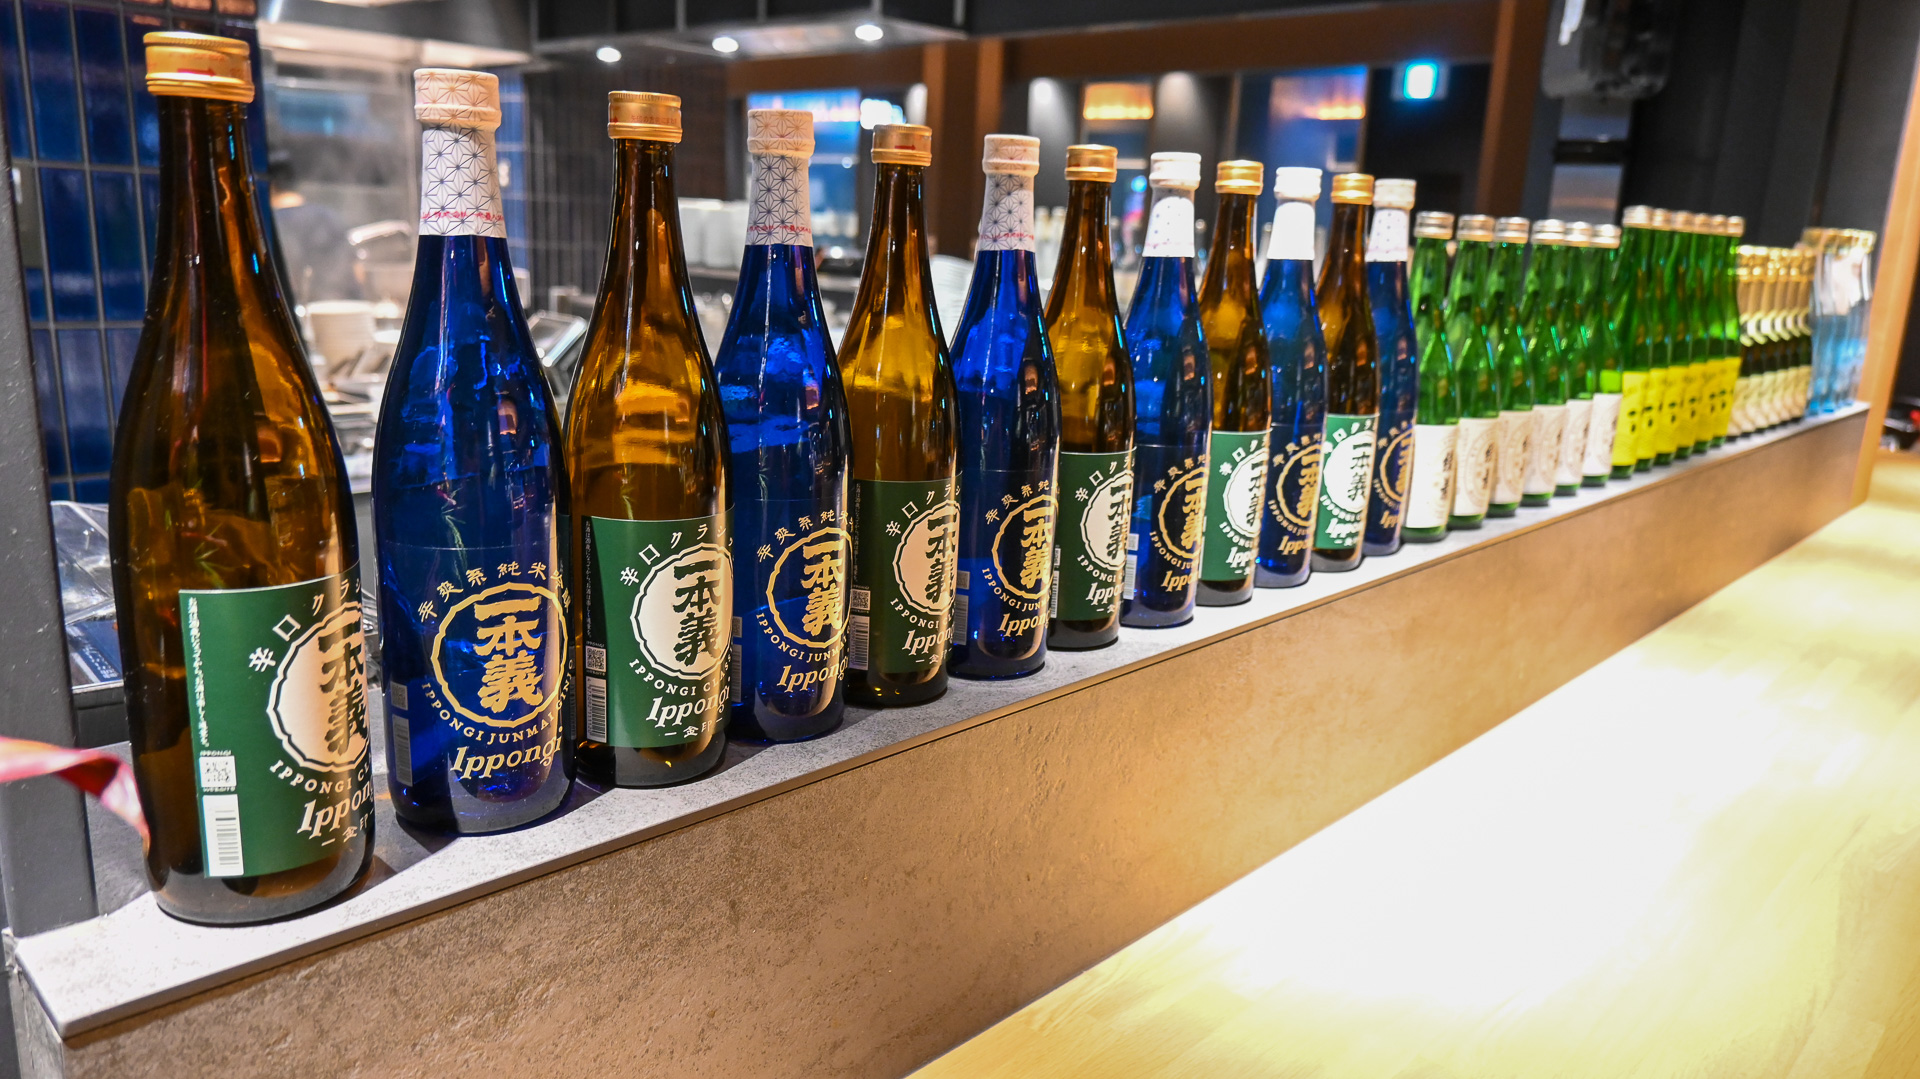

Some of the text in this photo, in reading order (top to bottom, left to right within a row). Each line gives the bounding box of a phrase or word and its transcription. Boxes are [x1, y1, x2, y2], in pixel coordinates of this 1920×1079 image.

[924, 512, 957, 604] 一本義
[1020, 506, 1053, 589] 一本義
[1077, 555, 1116, 582] IPPONGI
[1149, 531, 1182, 567] IPPONGI
[672, 559, 722, 667] 一本義
[801, 538, 844, 637] 一本義
[890, 598, 939, 629] IPPONGI
[982, 568, 1021, 609] IPPONGI
[473, 596, 543, 713] 一本義
[756, 613, 805, 660] IPPONGI
[318, 617, 368, 756] 一本義
[629, 659, 697, 696] IPPONGI
[645, 676, 730, 728] Ippongi
[421, 682, 484, 742] IPPONGI
[486, 711, 555, 746] JUNMAI
[269, 759, 352, 794] IPPONGI
[449, 726, 563, 780] Ippongi
